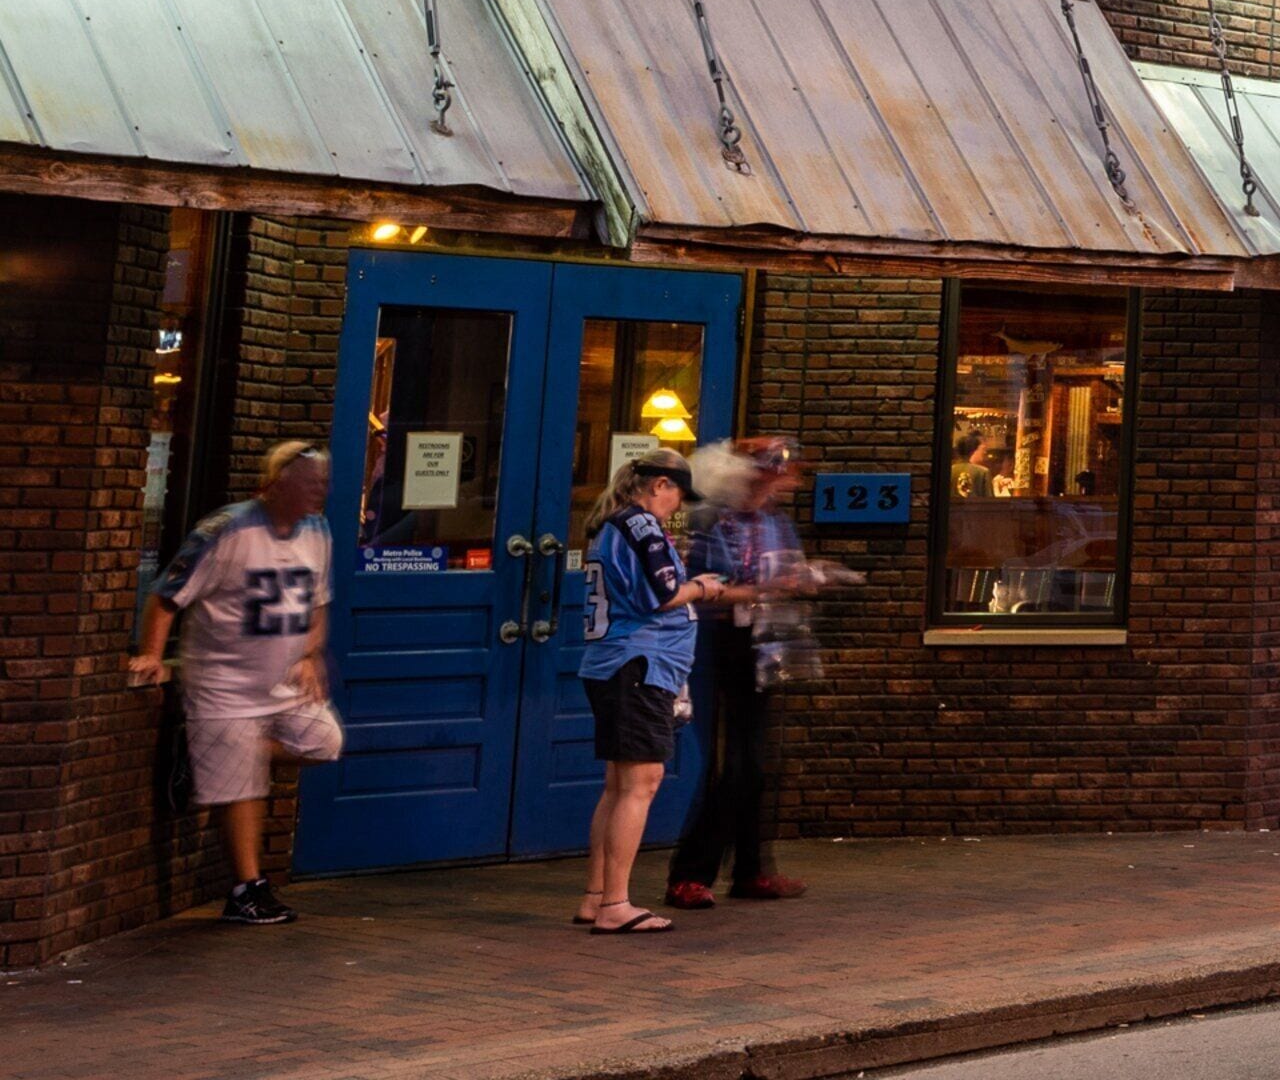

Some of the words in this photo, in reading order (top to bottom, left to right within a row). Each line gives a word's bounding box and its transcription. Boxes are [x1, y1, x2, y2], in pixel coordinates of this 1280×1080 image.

[626, 512, 664, 542] 23
[365, 563, 379, 571] NO
[382, 563, 439, 571] TRESPASSING
[243, 568, 314, 637] 23
